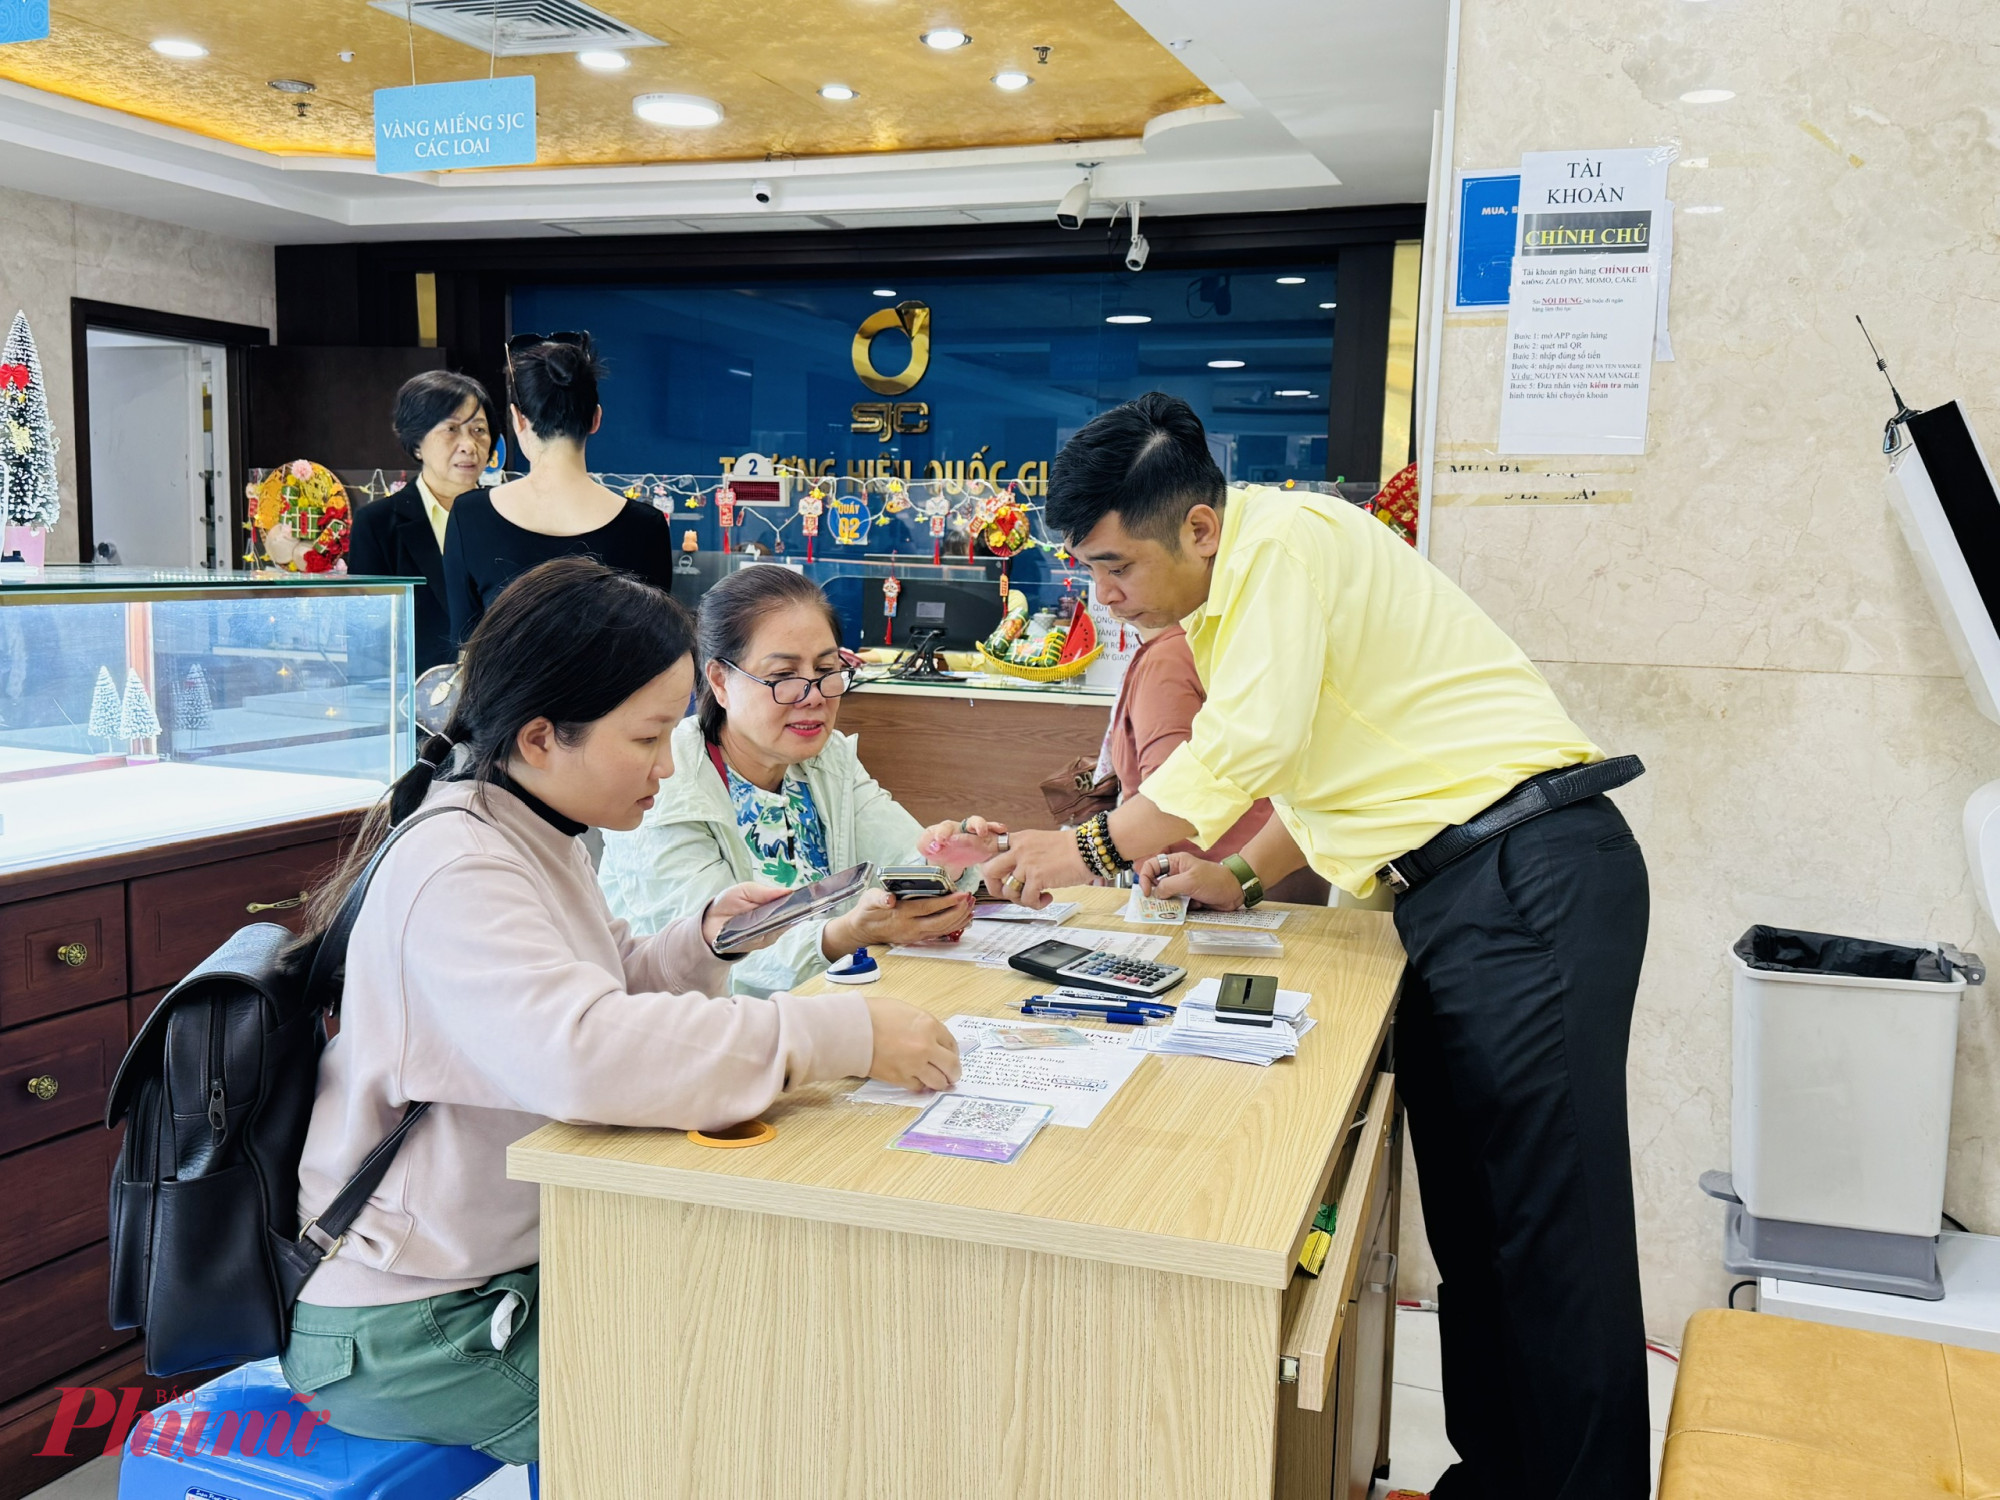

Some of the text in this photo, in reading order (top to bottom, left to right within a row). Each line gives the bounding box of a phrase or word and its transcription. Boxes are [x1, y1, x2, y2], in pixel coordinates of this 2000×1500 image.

[382, 111, 525, 139] VÀNG MIẾNG SJC
[415, 137, 490, 158] CÁC LOẠI
[1567, 158, 1602, 178] TÀI
[1547, 183, 1625, 204] KHOẢN
[1481, 206, 1518, 216] MUA, B
[1525, 223, 1648, 246] CHÍNH CHỦ
[1522, 268, 1534, 276] Tài
[1599, 265, 1629, 275] CHÍNH
[1615, 276, 1637, 284] CAKE
[1542, 297, 1556, 305] NỘI
[1571, 332, 1589, 341] ngân
[1590, 331, 1608, 340] hàng
[1569, 341, 1582, 350] QR
[1577, 350, 1586, 359] số
[1569, 372, 1586, 380] VAN
[1546, 391, 1558, 399] khi
[851, 402, 929, 442] SJC
[748, 458, 758, 476] 2
[924, 445, 1006, 496] QUỐC
[839, 517, 860, 539] 02
